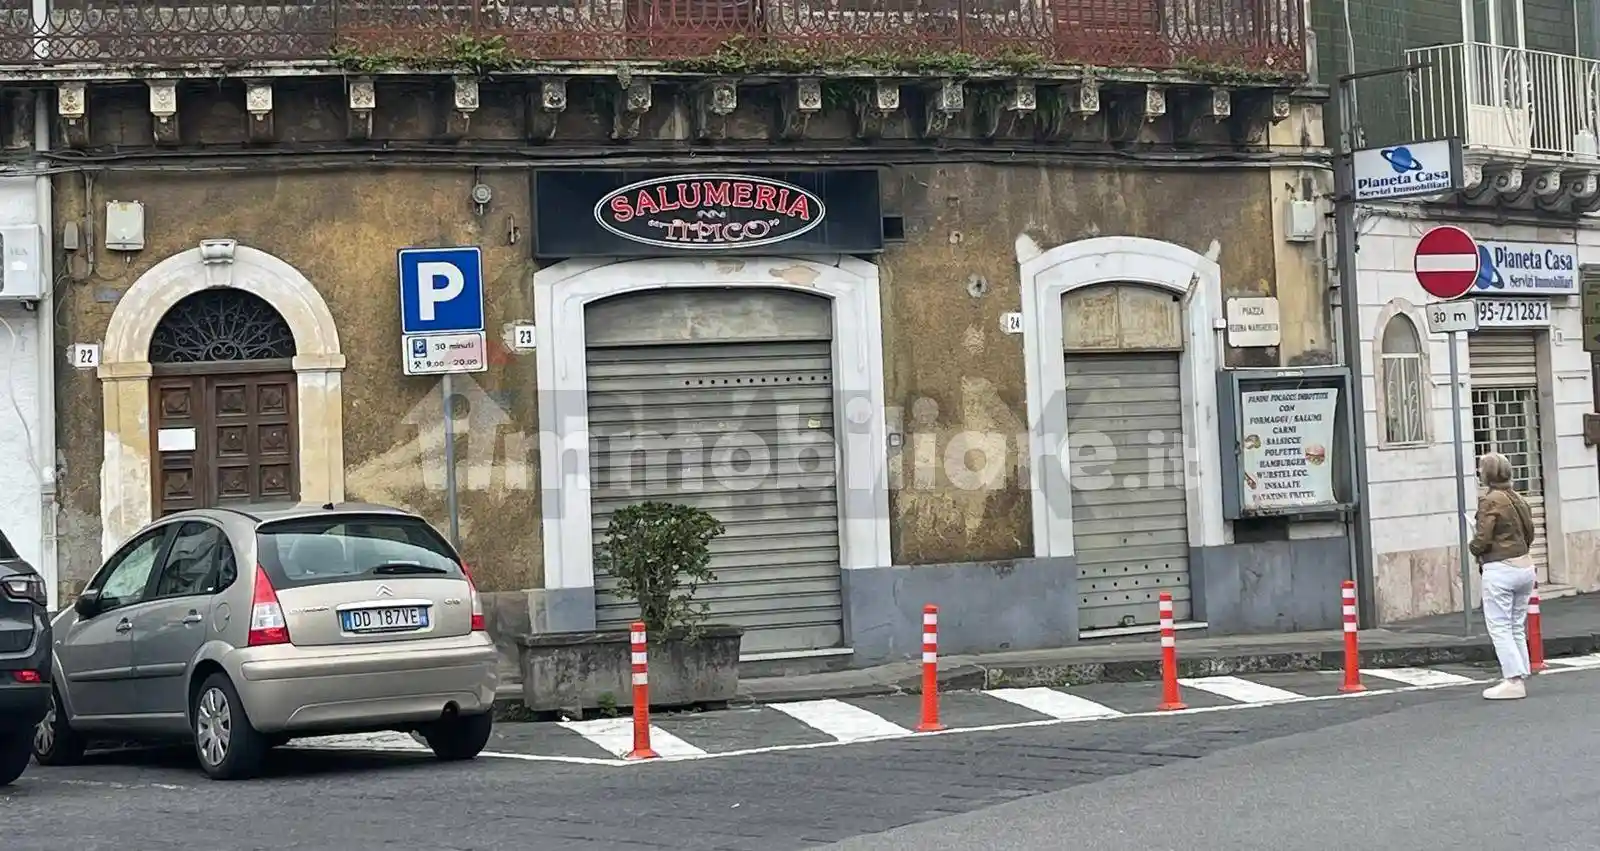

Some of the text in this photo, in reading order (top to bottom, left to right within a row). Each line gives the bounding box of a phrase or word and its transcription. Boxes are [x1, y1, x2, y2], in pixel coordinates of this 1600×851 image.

[1358, 170, 1449, 189] Pianeta Casa
[1358, 180, 1450, 197] Servizi Immobiliari
[610, 181, 811, 222] SALUMERIA
[1494, 246, 1573, 271] Pianeta Casa
[1509, 275, 1573, 289] Servizi Immobiliari
[417, 261, 465, 321] P
[1242, 307, 1265, 316] PIAZZA
[1433, 311, 1467, 323] 30 m
[1476, 302, 1549, 321] 95-7212821
[1010, 316, 1020, 330] 24
[519, 330, 532, 344] 23
[434, 341, 474, 351] 30 minuti
[80, 349, 93, 363] 22
[1249, 415, 1288, 424] FORMAGGI
[1294, 413, 1322, 422] SALUMI
[1272, 425, 1297, 434] CARNI
[1266, 436, 1302, 445] SALSICCE
[1264, 448, 1302, 457] POLPETTE
[1259, 459, 1307, 468] HAMBURGER
[1256, 470, 1292, 479] WURSTEL
[1264, 480, 1301, 490] INSALATE
[1251, 490, 1316, 502] PATATINE FRITTE
[352, 607, 419, 627] DD 187VE
